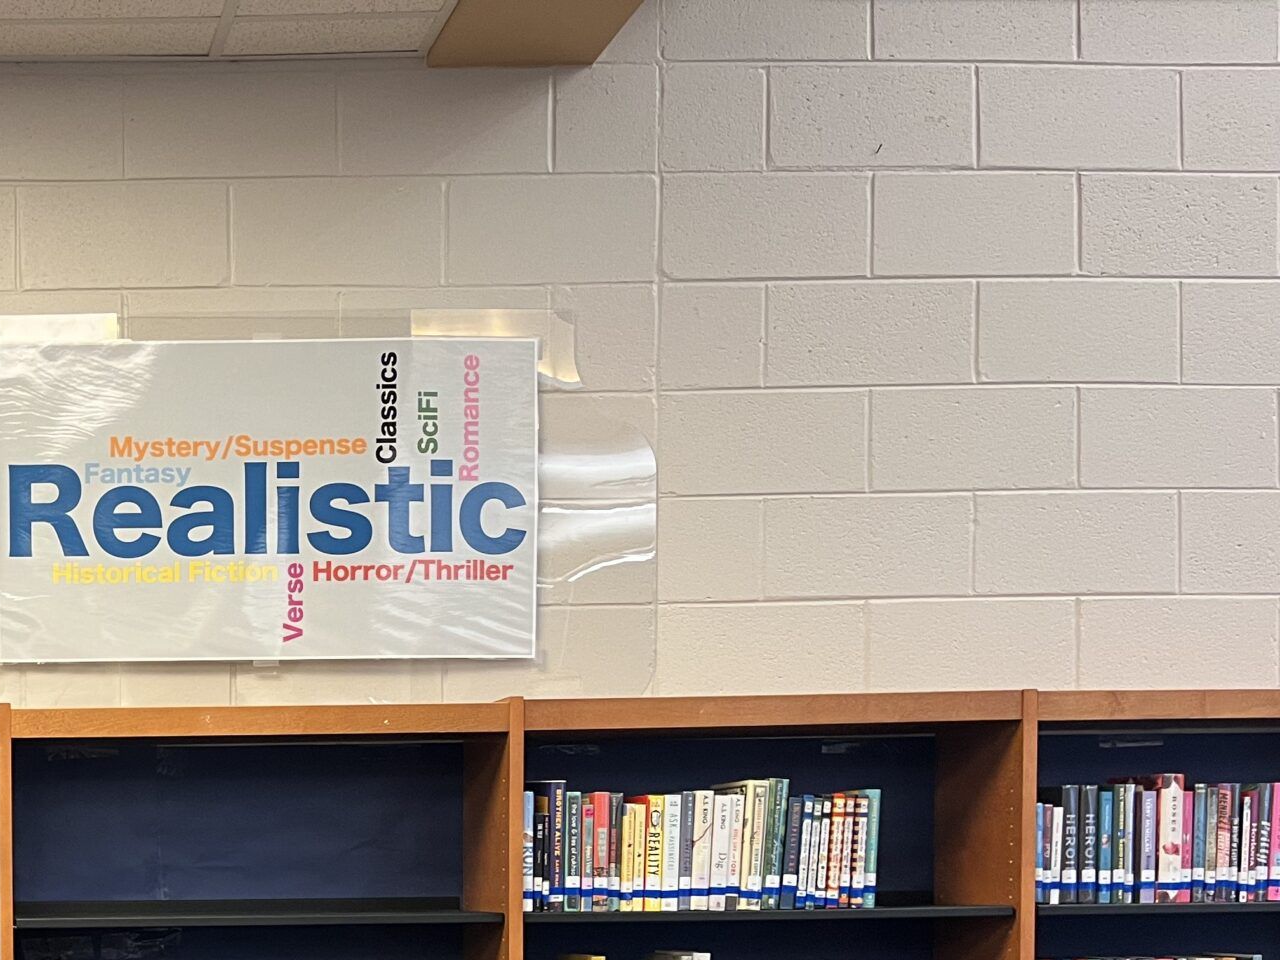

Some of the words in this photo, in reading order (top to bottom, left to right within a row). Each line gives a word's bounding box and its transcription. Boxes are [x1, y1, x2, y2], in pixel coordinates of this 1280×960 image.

[375, 351, 398, 464] Classics
[418, 391, 438, 454] SciFi
[459, 354, 480, 481] Romance
[109, 435, 367, 460] Mystery/Suspense
[85, 463, 191, 486] Fantasy
[7, 459, 527, 557] Realistic
[52, 562, 180, 584] Historical
[189, 562, 277, 584] Fiction
[312, 560, 514, 584] Horror/Thriller
[282, 562, 304, 642] Verse
[670, 813, 678, 827] ASK
[1219, 793, 1230, 825] MENDEZ
[648, 833, 659, 876] REALITY
